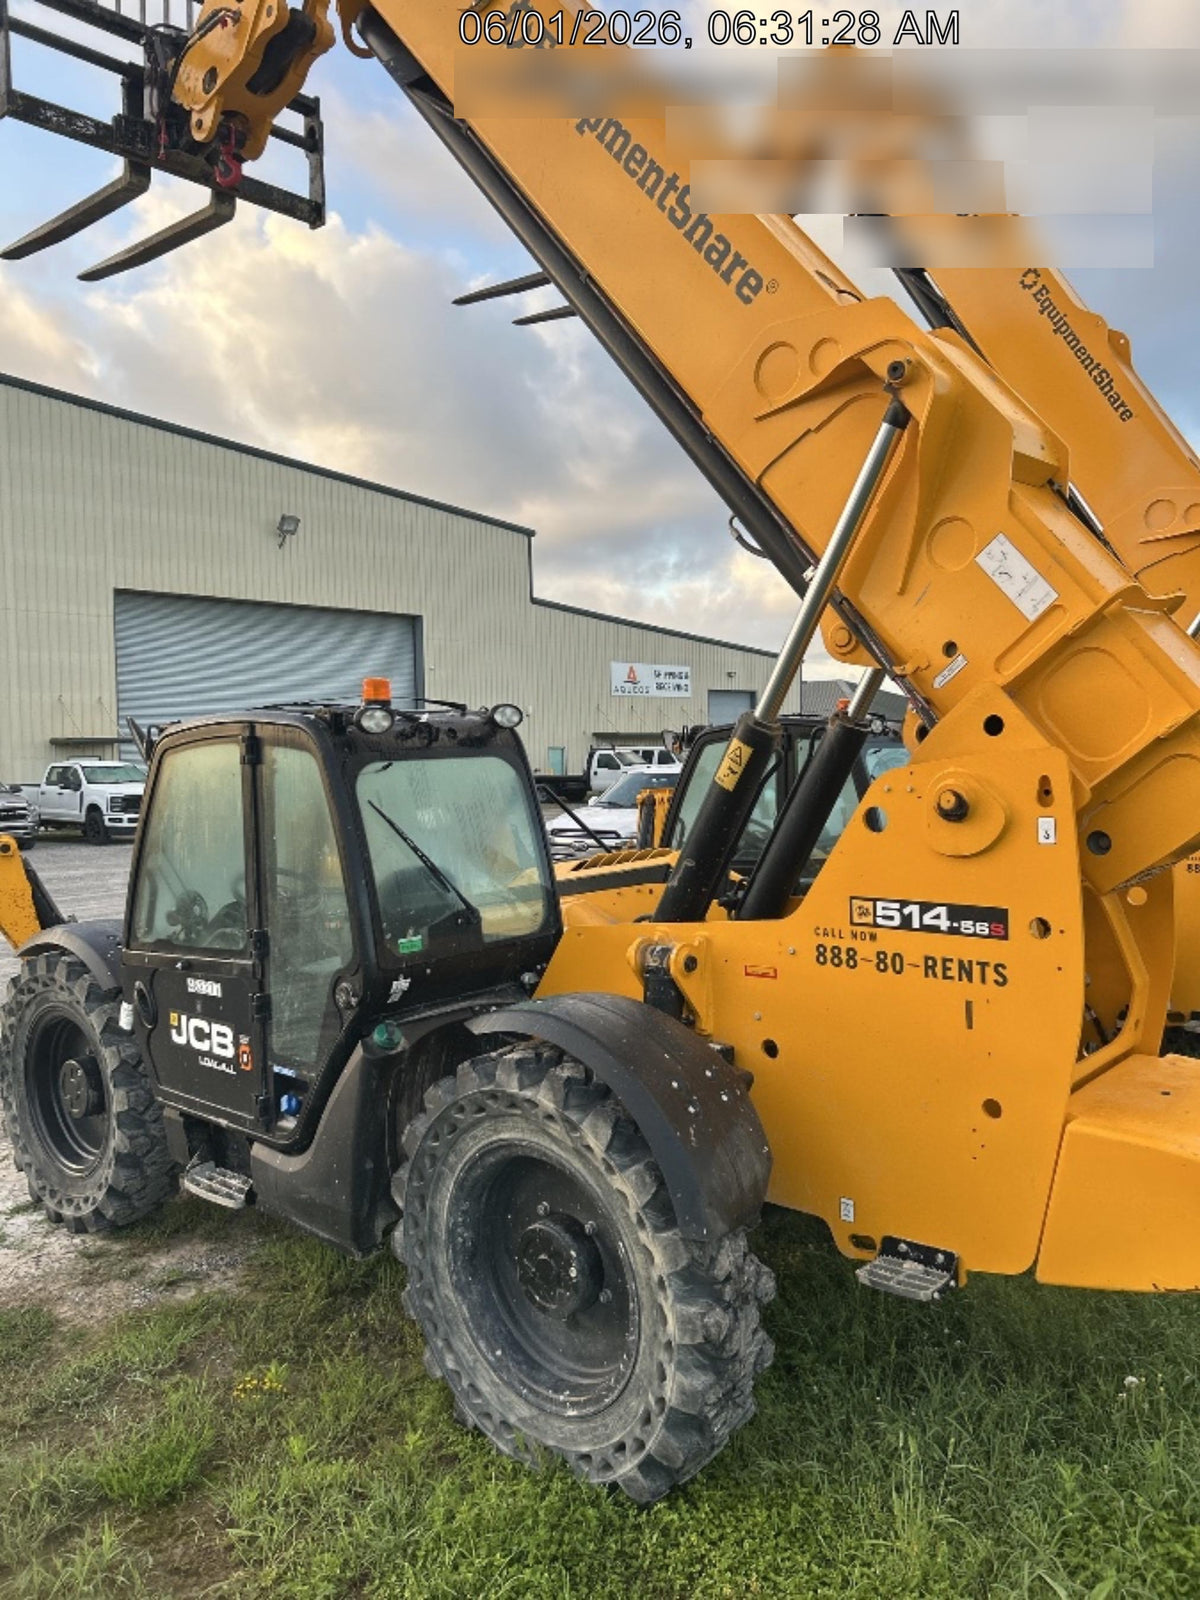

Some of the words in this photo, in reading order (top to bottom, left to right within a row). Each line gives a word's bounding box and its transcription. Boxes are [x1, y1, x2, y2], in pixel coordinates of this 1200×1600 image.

[1032, 284, 1134, 423] EquipmentShare
[814, 926, 845, 940] CALL
[851, 929, 878, 943] NOW
[170, 1014, 236, 1059] JCB
